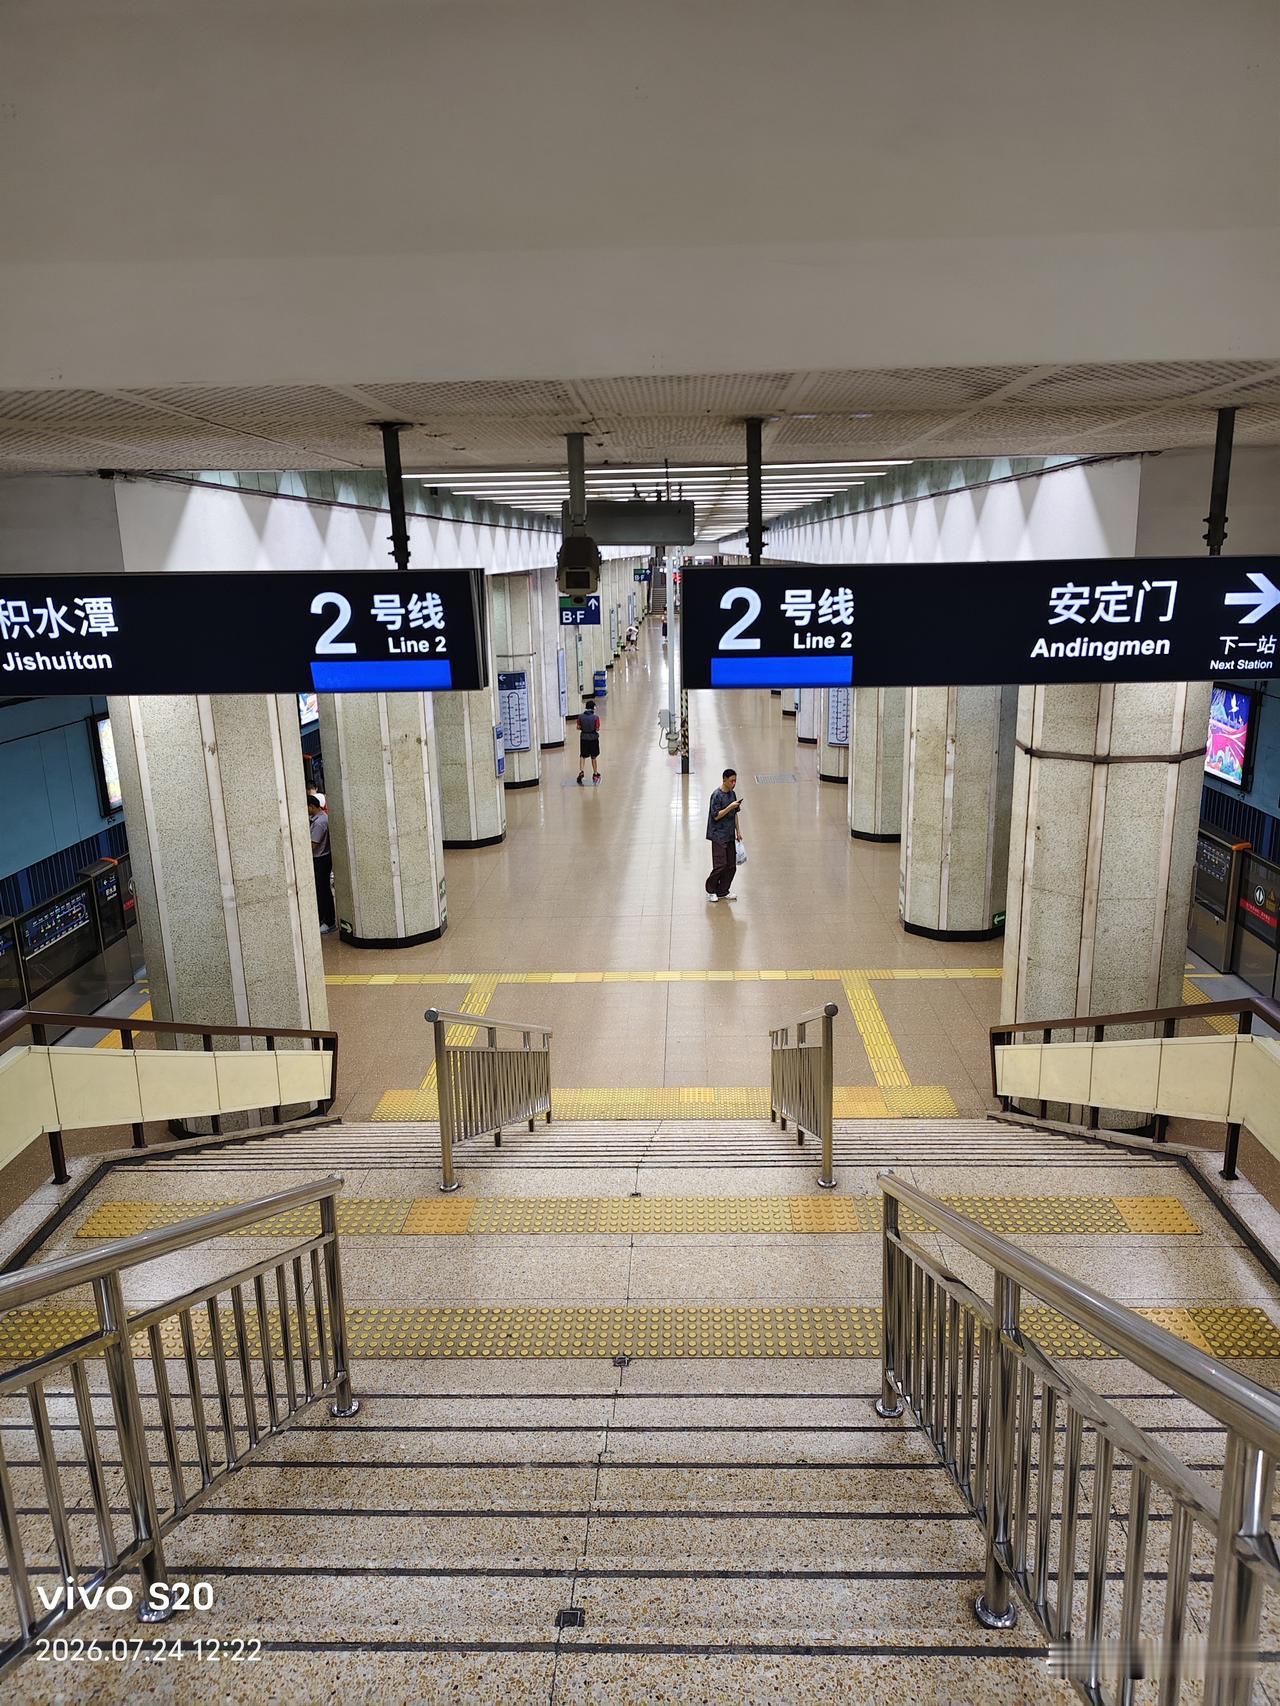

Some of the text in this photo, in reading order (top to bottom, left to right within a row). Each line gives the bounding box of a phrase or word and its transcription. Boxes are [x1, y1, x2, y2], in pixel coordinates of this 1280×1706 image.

[370, 592, 446, 631] 号线
[718, 586, 762, 650] 2
[780, 587, 855, 627] 号线
[1047, 579, 1178, 625] 安定门
[0, 597, 119, 640] 积水潭
[310, 591, 357, 655] 2
[387, 635, 447, 653] Line 2
[793, 631, 853, 650] Line 2
[1030, 636, 1171, 662] Andingmen
[1219, 634, 1278, 655] 下一站
[2, 650, 113, 672] Jishuitan
[1209, 659, 1273, 670] Next Station
